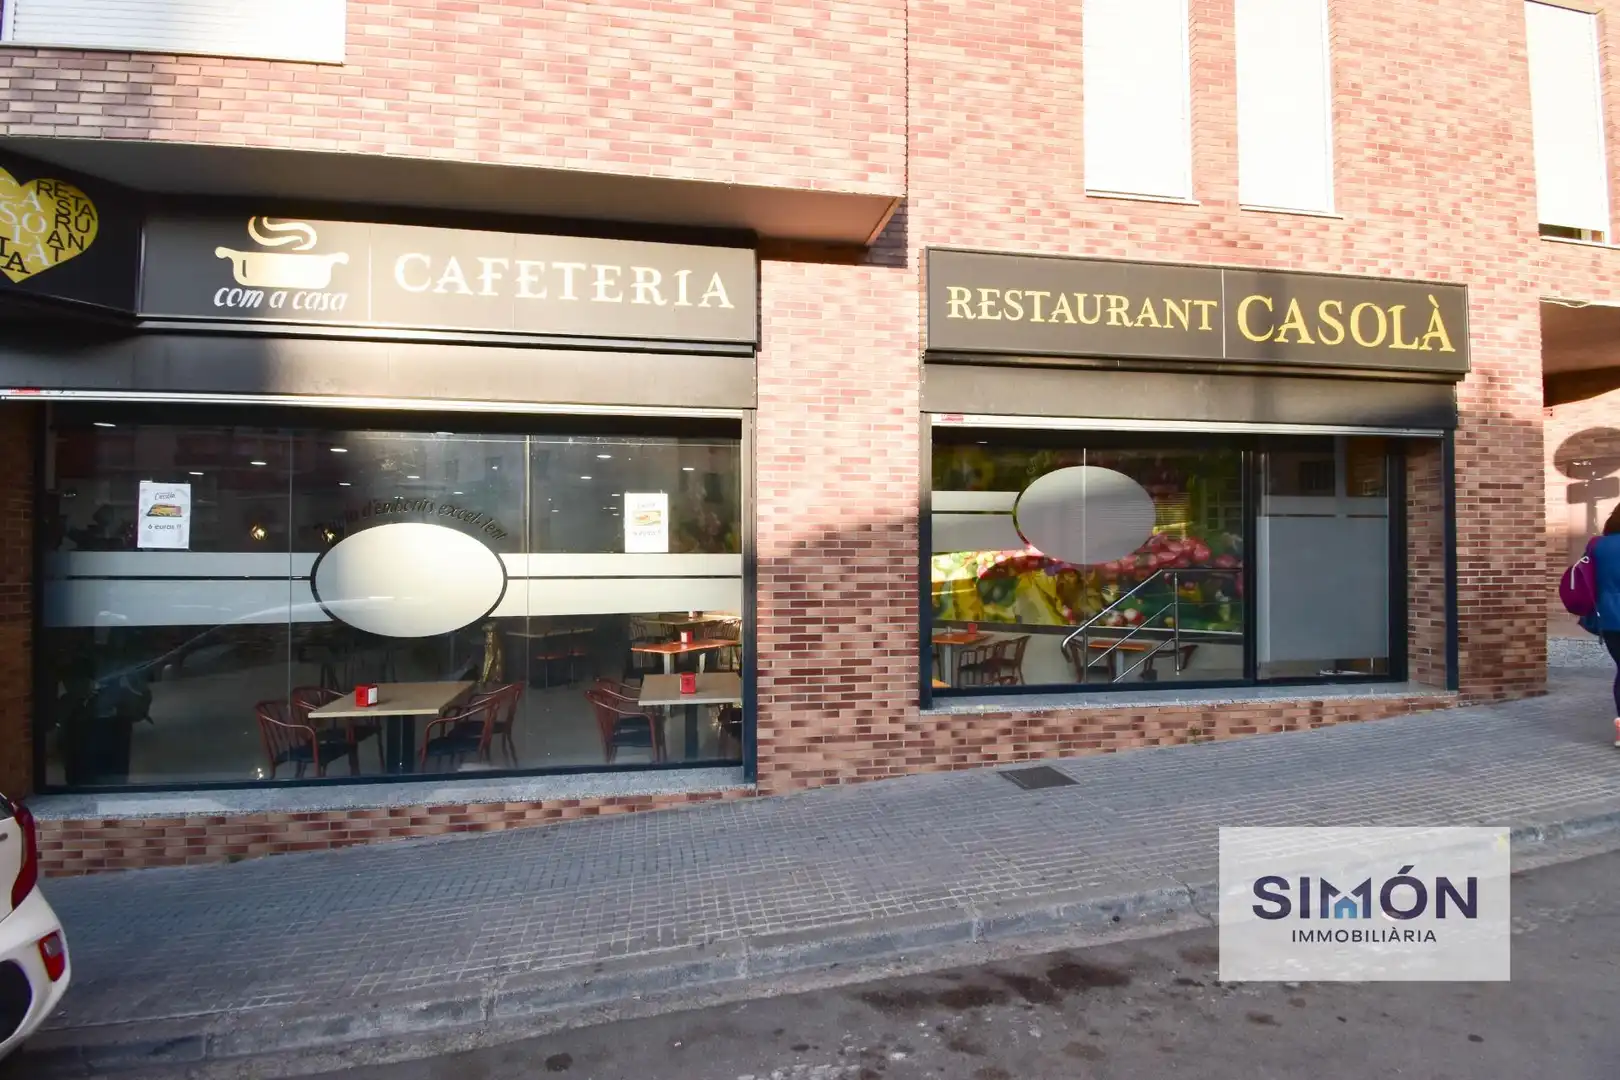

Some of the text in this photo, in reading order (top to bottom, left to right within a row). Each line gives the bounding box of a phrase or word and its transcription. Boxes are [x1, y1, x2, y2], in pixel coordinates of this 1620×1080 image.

[213, 287, 349, 312] com a casa
[394, 252, 735, 308] CAFETERIA
[946, 286, 1456, 353] RESTAURANT CASOLÀ
